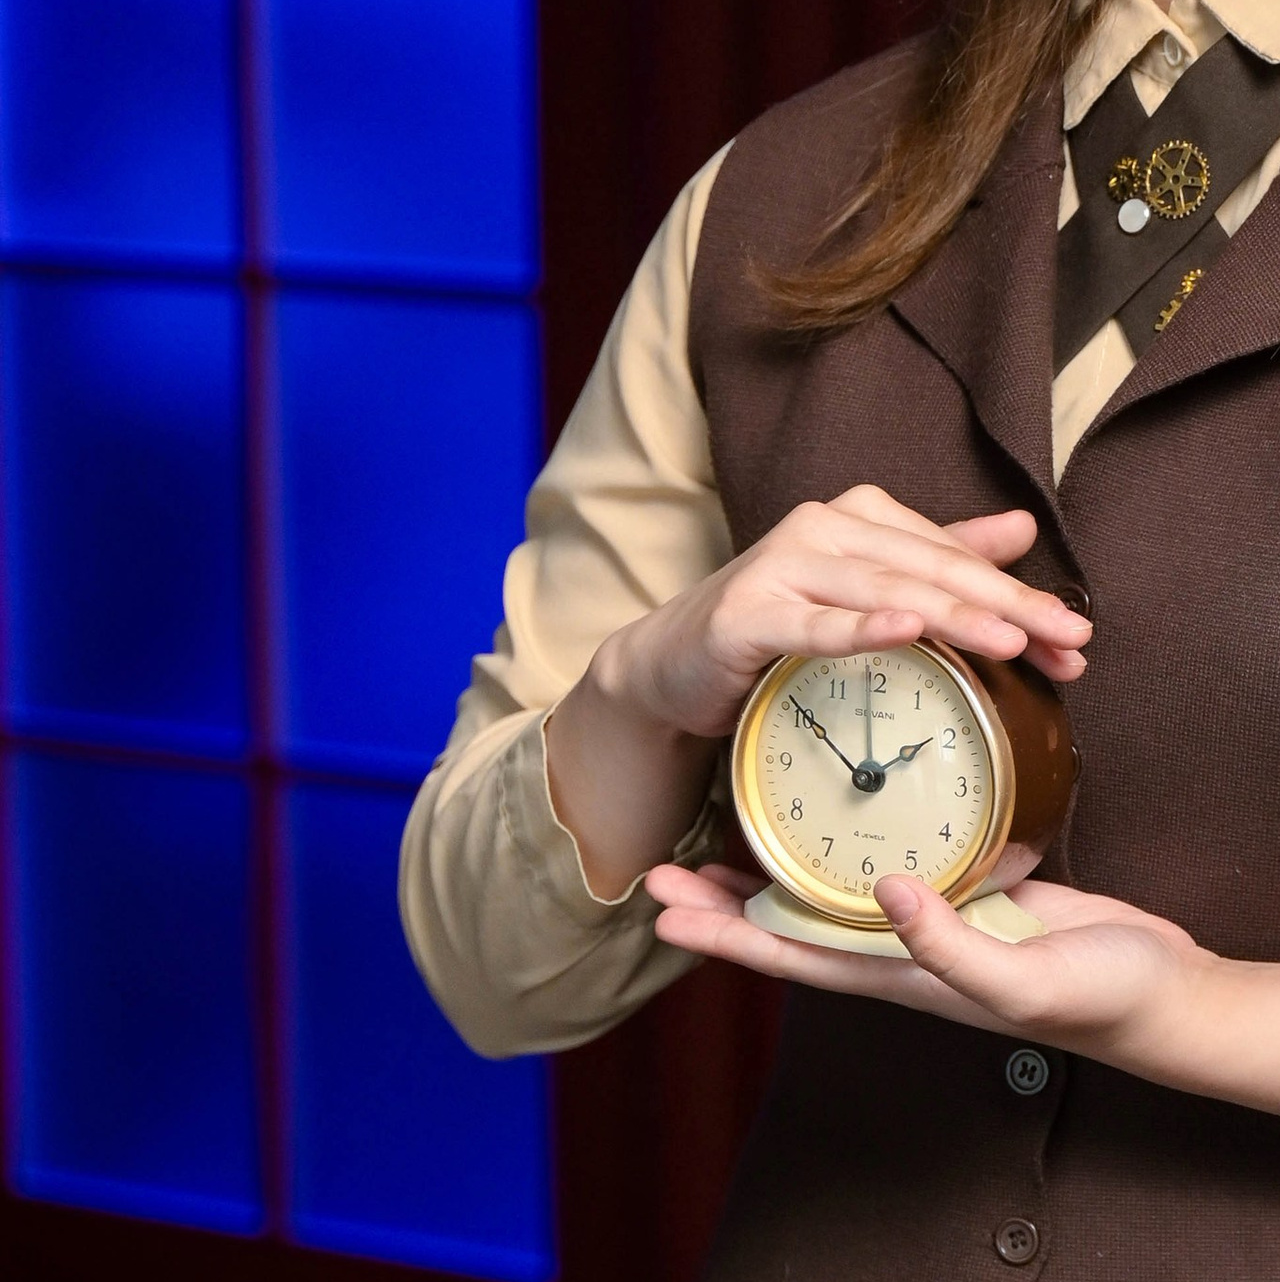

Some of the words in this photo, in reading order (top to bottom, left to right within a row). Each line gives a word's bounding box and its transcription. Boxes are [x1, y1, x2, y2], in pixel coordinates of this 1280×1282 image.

[828, 678, 846, 700] 11
[865, 671, 887, 694] 12
[914, 690, 921, 710] 1
[794, 708, 814, 729] 10
[942, 727, 956, 749] 2
[780, 751, 792, 772] 9
[954, 776, 967, 798] 3
[790, 798, 803, 821] 8
[861, 833, 886, 841] JEWELS
[938, 822, 952, 842] 4
[822, 836, 835, 857] 7
[861, 855, 875, 876] 6
[904, 849, 918, 871] 5
